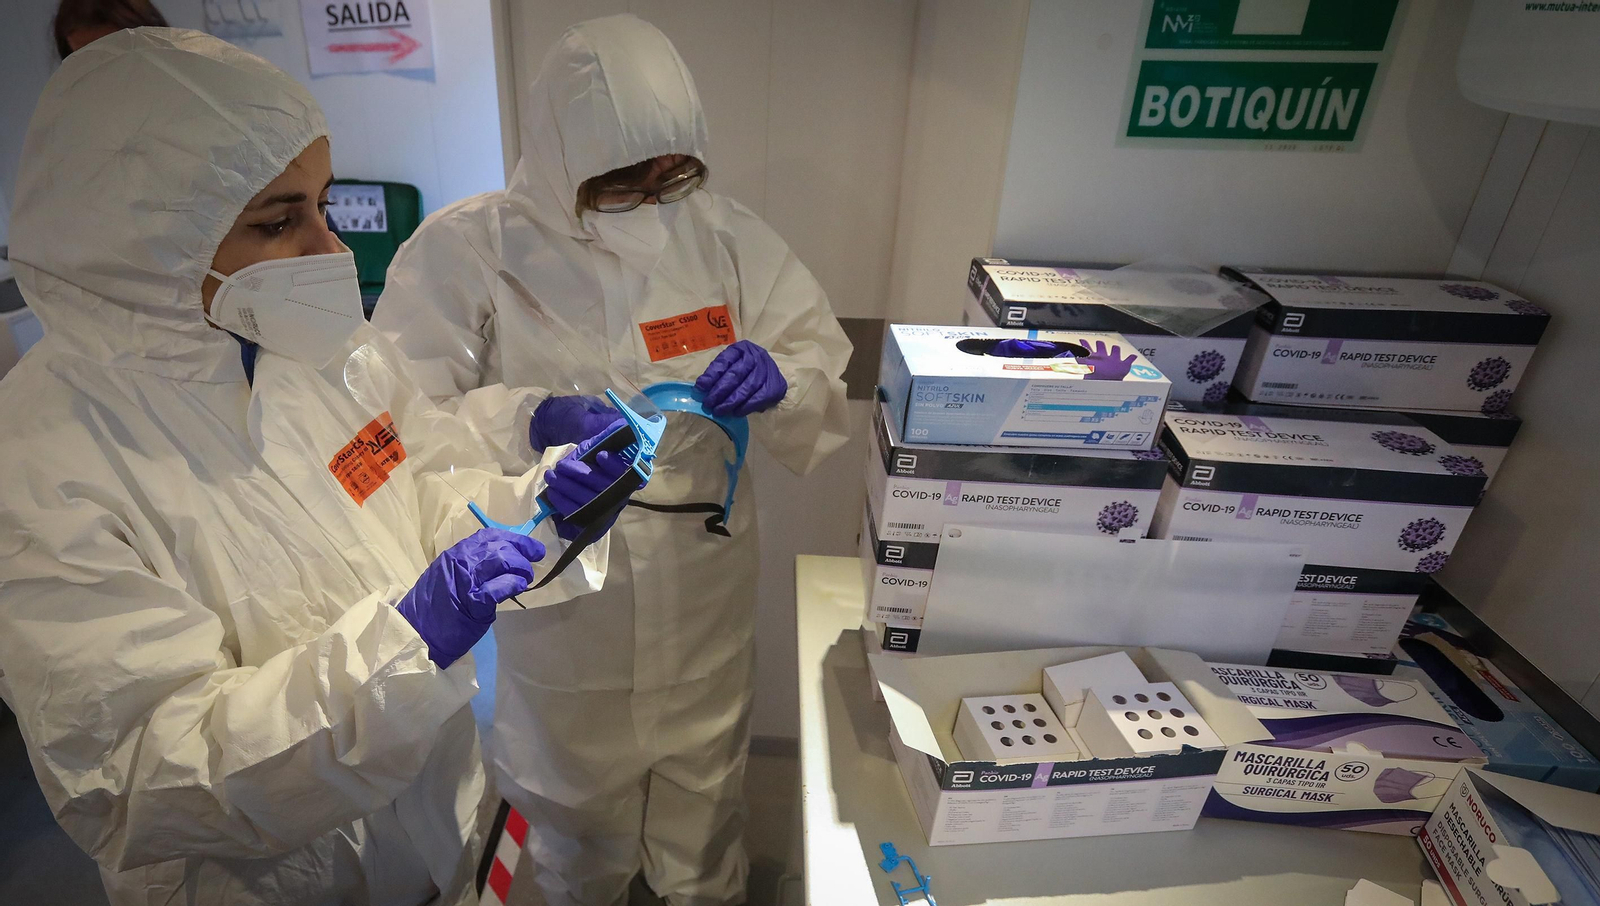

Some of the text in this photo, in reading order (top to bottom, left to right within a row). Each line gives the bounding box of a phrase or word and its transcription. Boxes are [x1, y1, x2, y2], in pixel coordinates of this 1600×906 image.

[326, 1, 410, 26] SALIDA
[1138, 77, 1360, 132] BOTIQUÍN
[1273, 348, 1322, 360] COVID-19
[1340, 352, 1438, 364] RAPID TEST DEVICE
[917, 392, 985, 403] SOFTSKIN
[1174, 418, 1243, 430] COVID-19
[1180, 426, 1326, 443] RAPID TEST DEVICE
[892, 490, 942, 501] COVID-19
[961, 494, 1062, 507] RAPID TEST DEVICE
[985, 504, 1060, 514] (NASOPHARYNGEAL)
[1183, 502, 1235, 514] COVID-19
[1256, 508, 1364, 523] RAPID TEST DEVICE
[1281, 518, 1361, 530] (NASOPHARYNGEAL)
[881, 577, 928, 588] COVID-19
[1299, 574, 1358, 584] EST DEVICE
[1211, 667, 1286, 680] ASCARILLA
[1298, 673, 1319, 682] 50
[1284, 699, 1318, 710] MASK
[1233, 751, 1327, 770] MASCARILLA
[1052, 765, 1156, 779] RAPID TEST DEVICE
[1340, 765, 1365, 774] 50
[980, 773, 1049, 783] COVID-19 Ag
[1272, 778, 1297, 786] CAPAS
[1298, 780, 1315, 788] TIPO
[1242, 786, 1335, 803] SURGICAL MASK
[1466, 794, 1496, 843] NORUCO
[1450, 803, 1486, 868] MASCARILLA
[1423, 835, 1432, 850] 50
[1444, 812, 1482, 877] DESECHABLE
[1433, 829, 1462, 881] FACE MASK
[1438, 821, 1470, 877] DISPOSABLE
